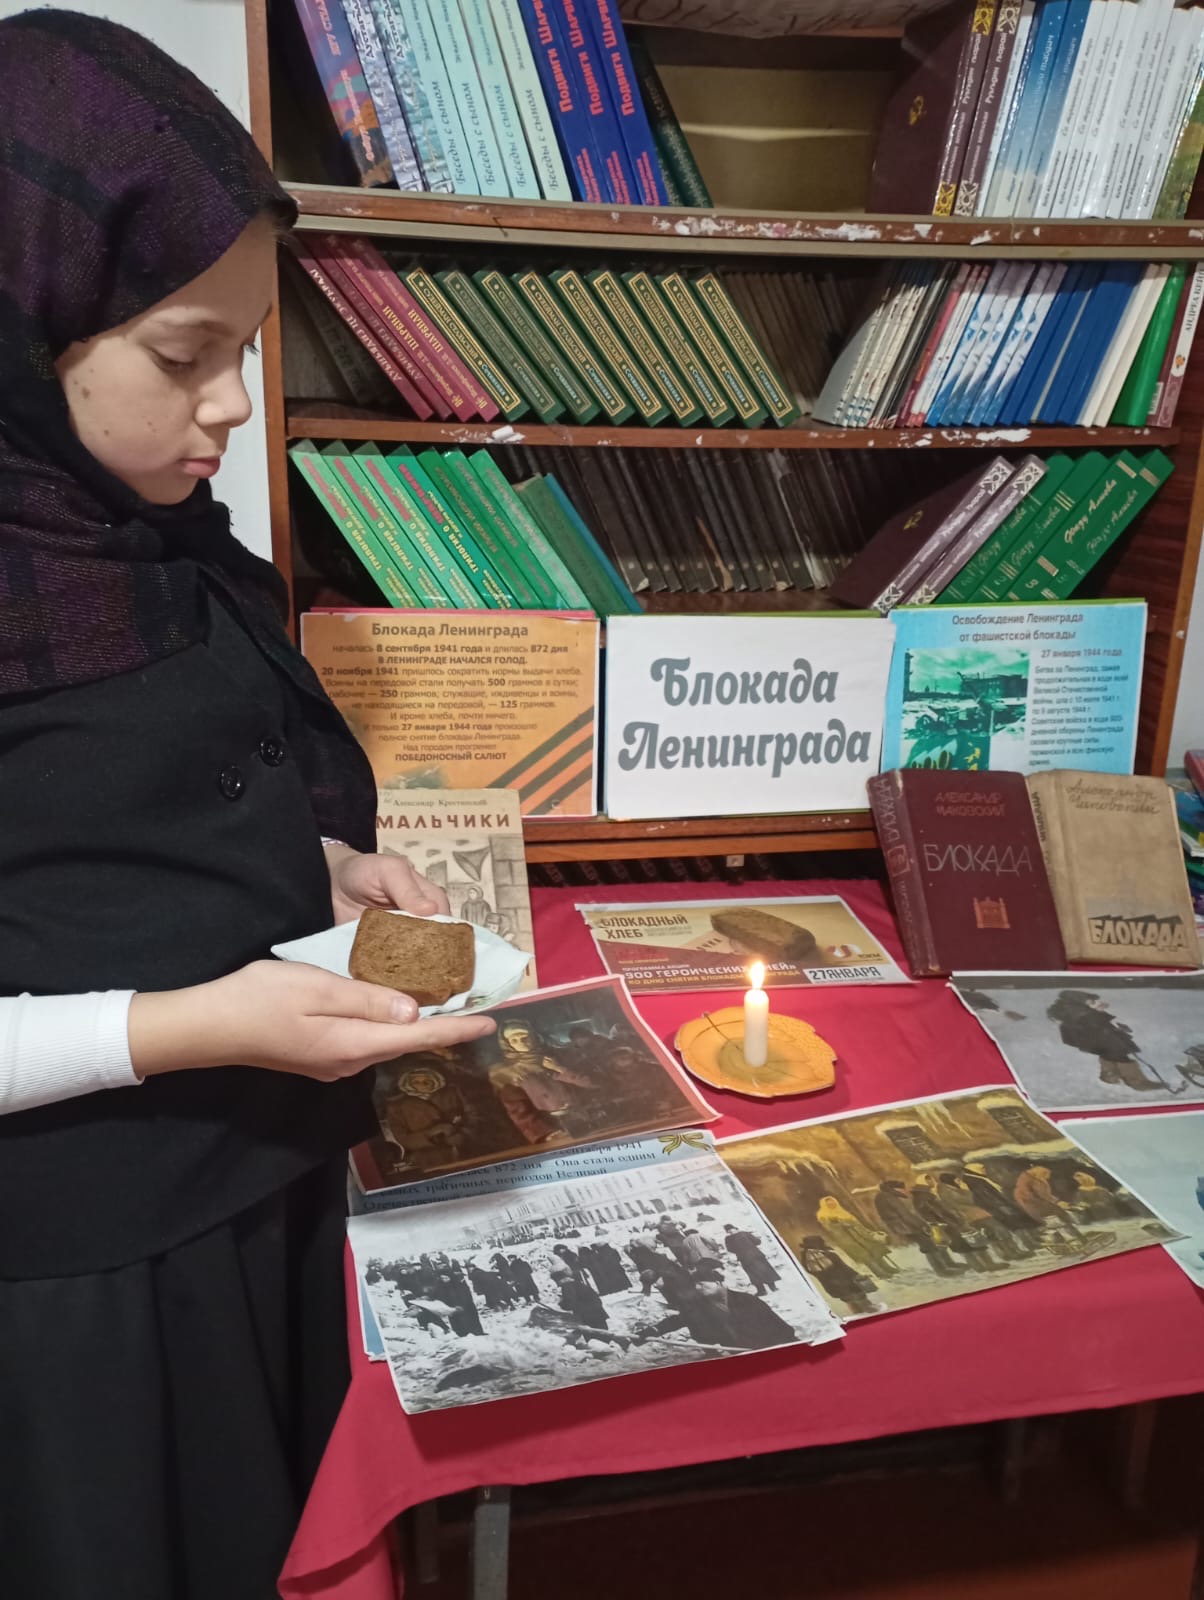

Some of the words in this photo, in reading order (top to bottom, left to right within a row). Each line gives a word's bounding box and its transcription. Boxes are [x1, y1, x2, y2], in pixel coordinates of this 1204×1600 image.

[430, 79, 449, 125] сыном
[460, 81, 480, 126] сыном
[491, 83, 510, 128] сыном
[524, 88, 543, 132] сыном
[442, 126, 452, 135] с
[472, 127, 482, 136] с
[504, 130, 513, 138] с
[444, 136, 466, 184] Беседы
[474, 138, 496, 186] Беседы
[505, 139, 527, 188] Беседы
[537, 143, 559, 190] Беседы
[952, 614, 1025, 626] Освобождение
[1027, 612, 1084, 625] Ленинграда
[371, 623, 435, 638] Блокада
[439, 623, 528, 639] Ленинграда
[959, 633, 970, 642] от
[972, 630, 1031, 643] фашистской
[1033, 629, 1076, 641] блокады
[385, 644, 431, 654] сентября
[434, 644, 457, 653] 1941
[460, 645, 483, 653] года
[530, 644, 548, 653] 872
[1041, 649, 1051, 658] 27
[378, 656, 384, 664] В
[386, 656, 447, 665] ЛЕНИНГРАДЕ
[449, 656, 492, 664] НАЧАЛСЯ
[495, 656, 528, 665] ГОЛОД.
[321, 667, 334, 676] 20
[376, 667, 399, 675] 1941
[487, 678, 506, 687] 500
[650, 656, 839, 706] Блокада
[380, 690, 398, 698] 250
[500, 700, 518, 709] 125
[401, 723, 412, 731] 27
[618, 718, 872, 778] Ленинграда
[395, 752, 472, 762] ПОБЕДОНОСНЫЙ
[474, 752, 507, 760] САЛЮТ
[375, 813, 510, 829] МАЛЬЧИКИ
[923, 843, 1033, 876] БЛОКАДА
[604, 928, 644, 939] ХЛЕБ
[1088, 915, 1188, 948] БЛОКАДА
